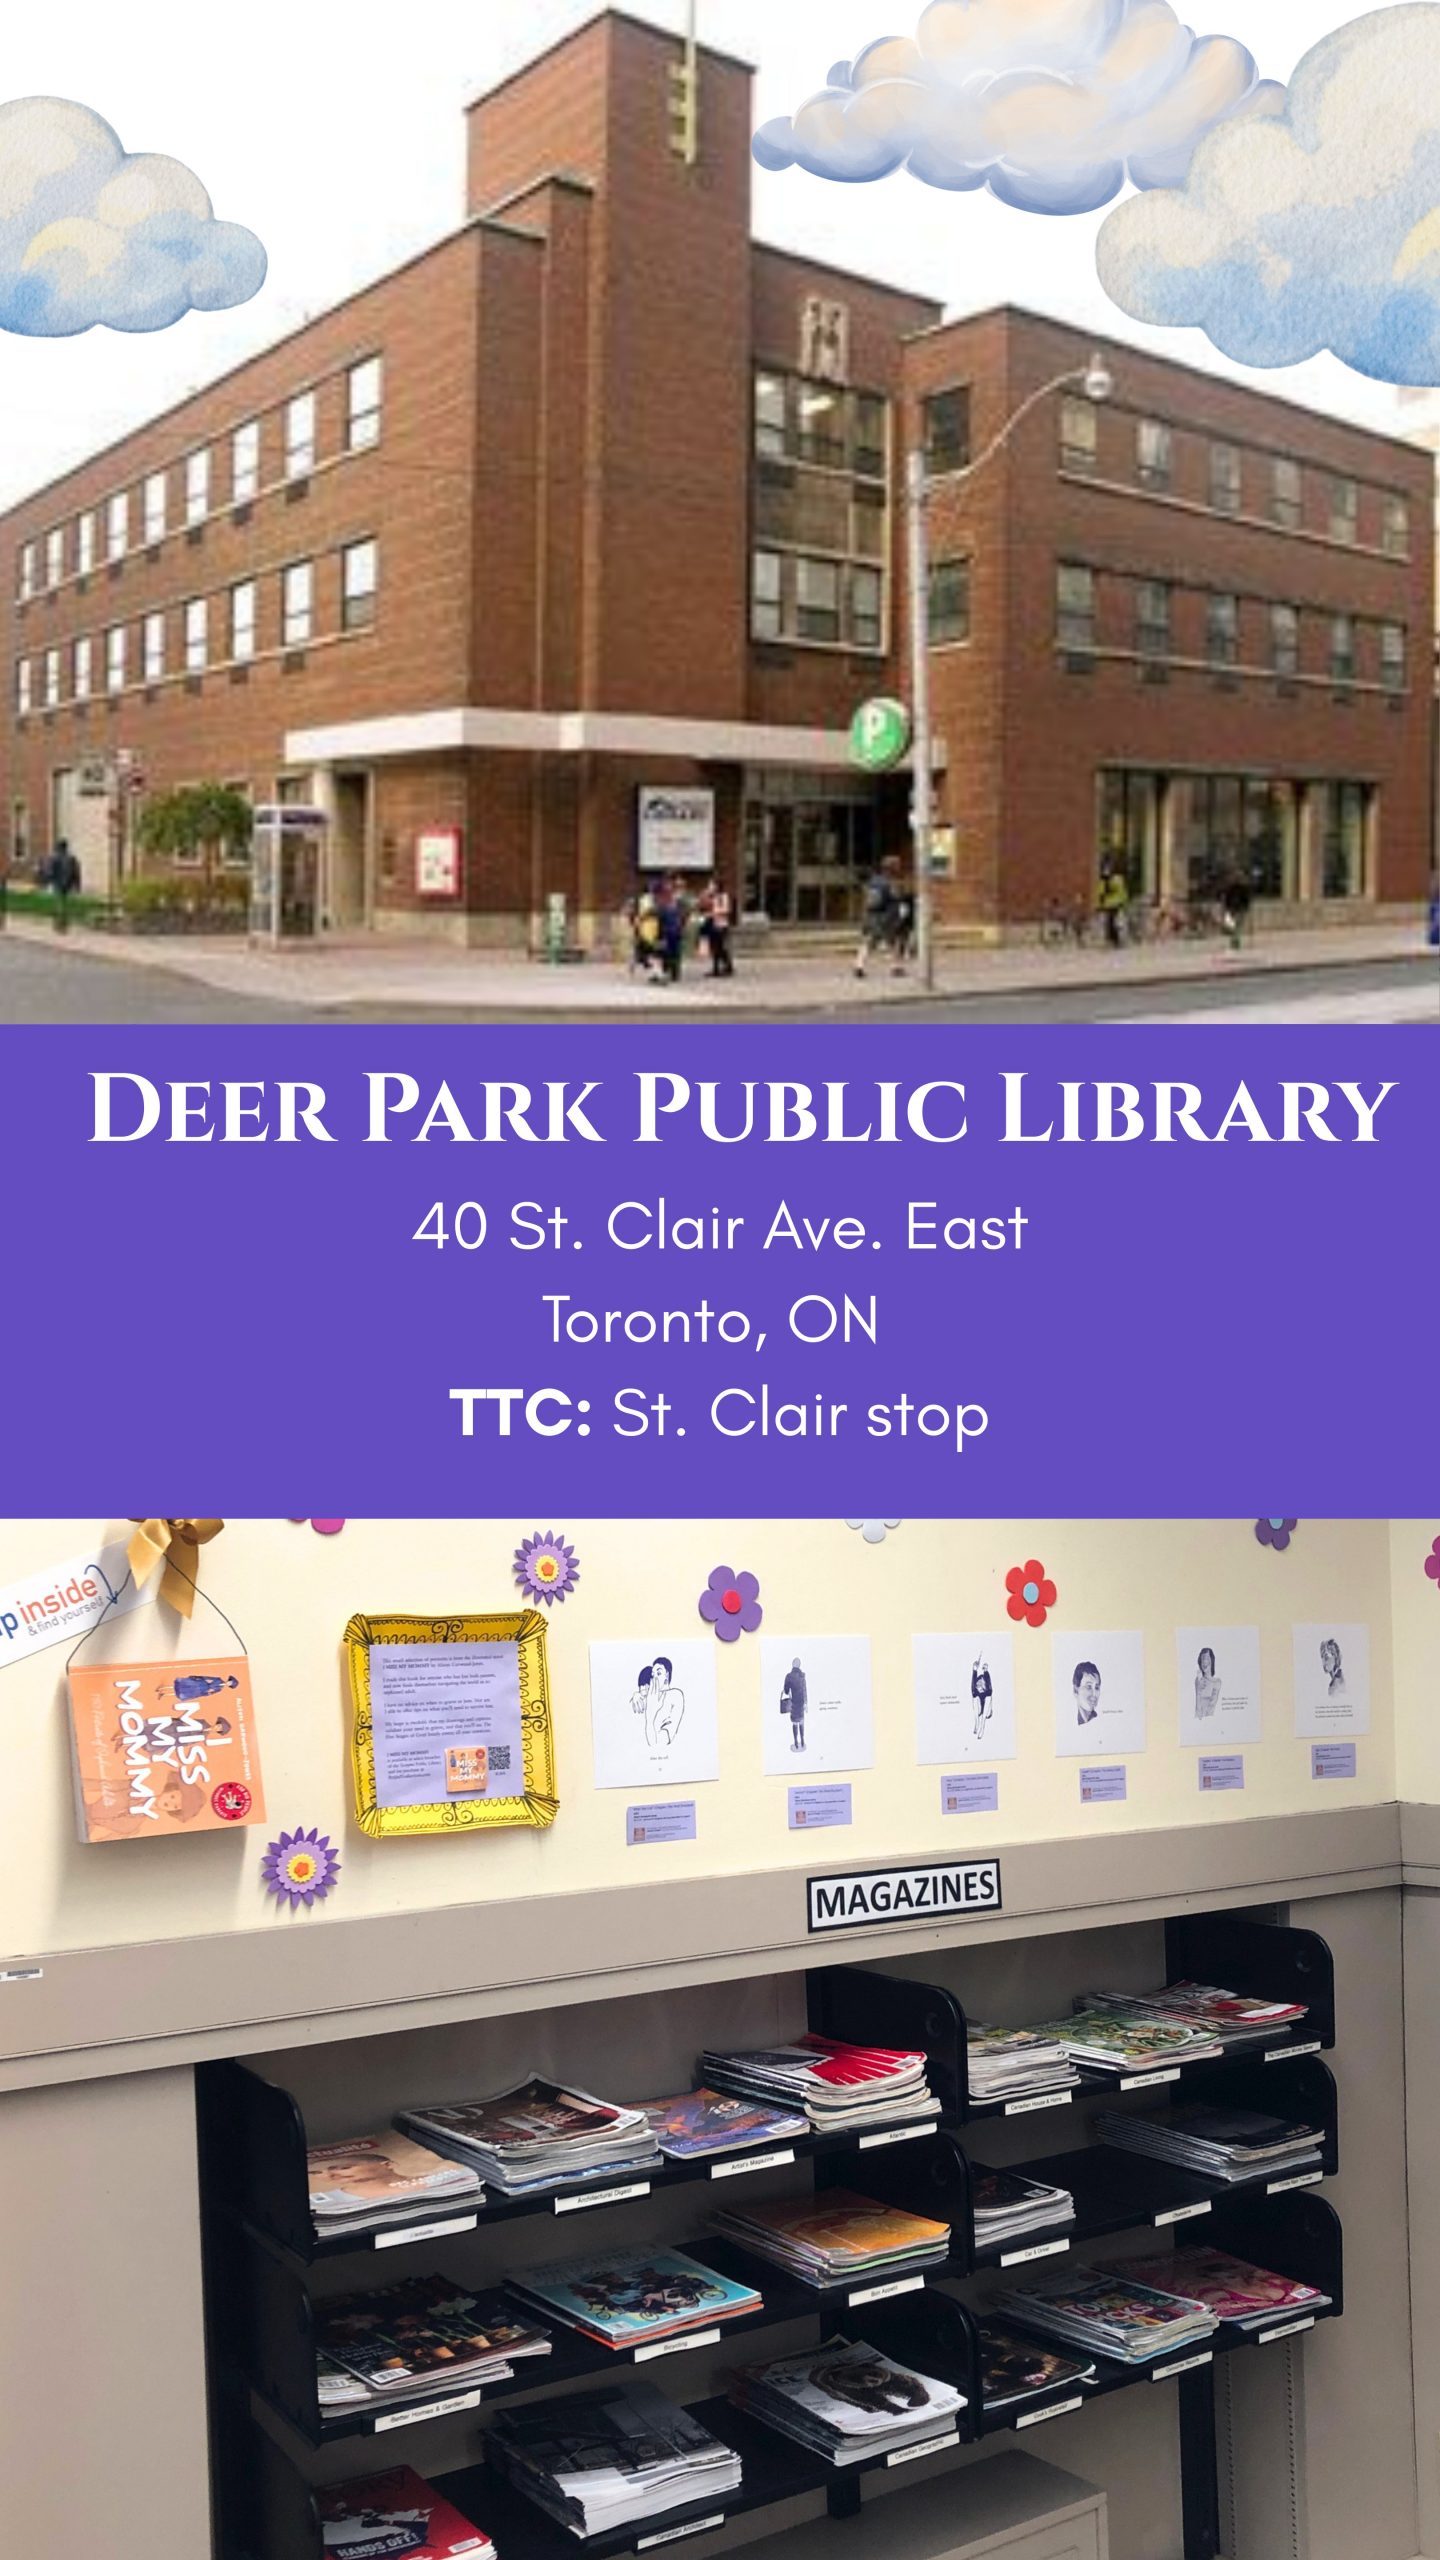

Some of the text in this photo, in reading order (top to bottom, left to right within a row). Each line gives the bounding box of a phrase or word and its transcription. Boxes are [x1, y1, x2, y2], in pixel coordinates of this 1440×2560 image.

[863, 702, 887, 749] P
[16, 1578, 98, 1624] inside
[37, 1617, 59, 1632] find
[60, 1596, 104, 1624] yourself
[114, 1680, 160, 1820] MOMMY
[147, 1716, 179, 1768] MY
[174, 1702, 211, 1785] MISS
[205, 1737, 233, 1746] I
[816, 1870, 995, 1919] MAGAZINES
[749, 2155, 774, 2167] Magazine
[577, 2186, 633, 2204] Architectural Digest
[390, 2412, 411, 2424] Better
[411, 2407, 434, 2420] Homes
[442, 2399, 465, 2412] Garden
[337, 2541, 387, 2558] HANDS
[386, 2532, 420, 2548] OFF!
